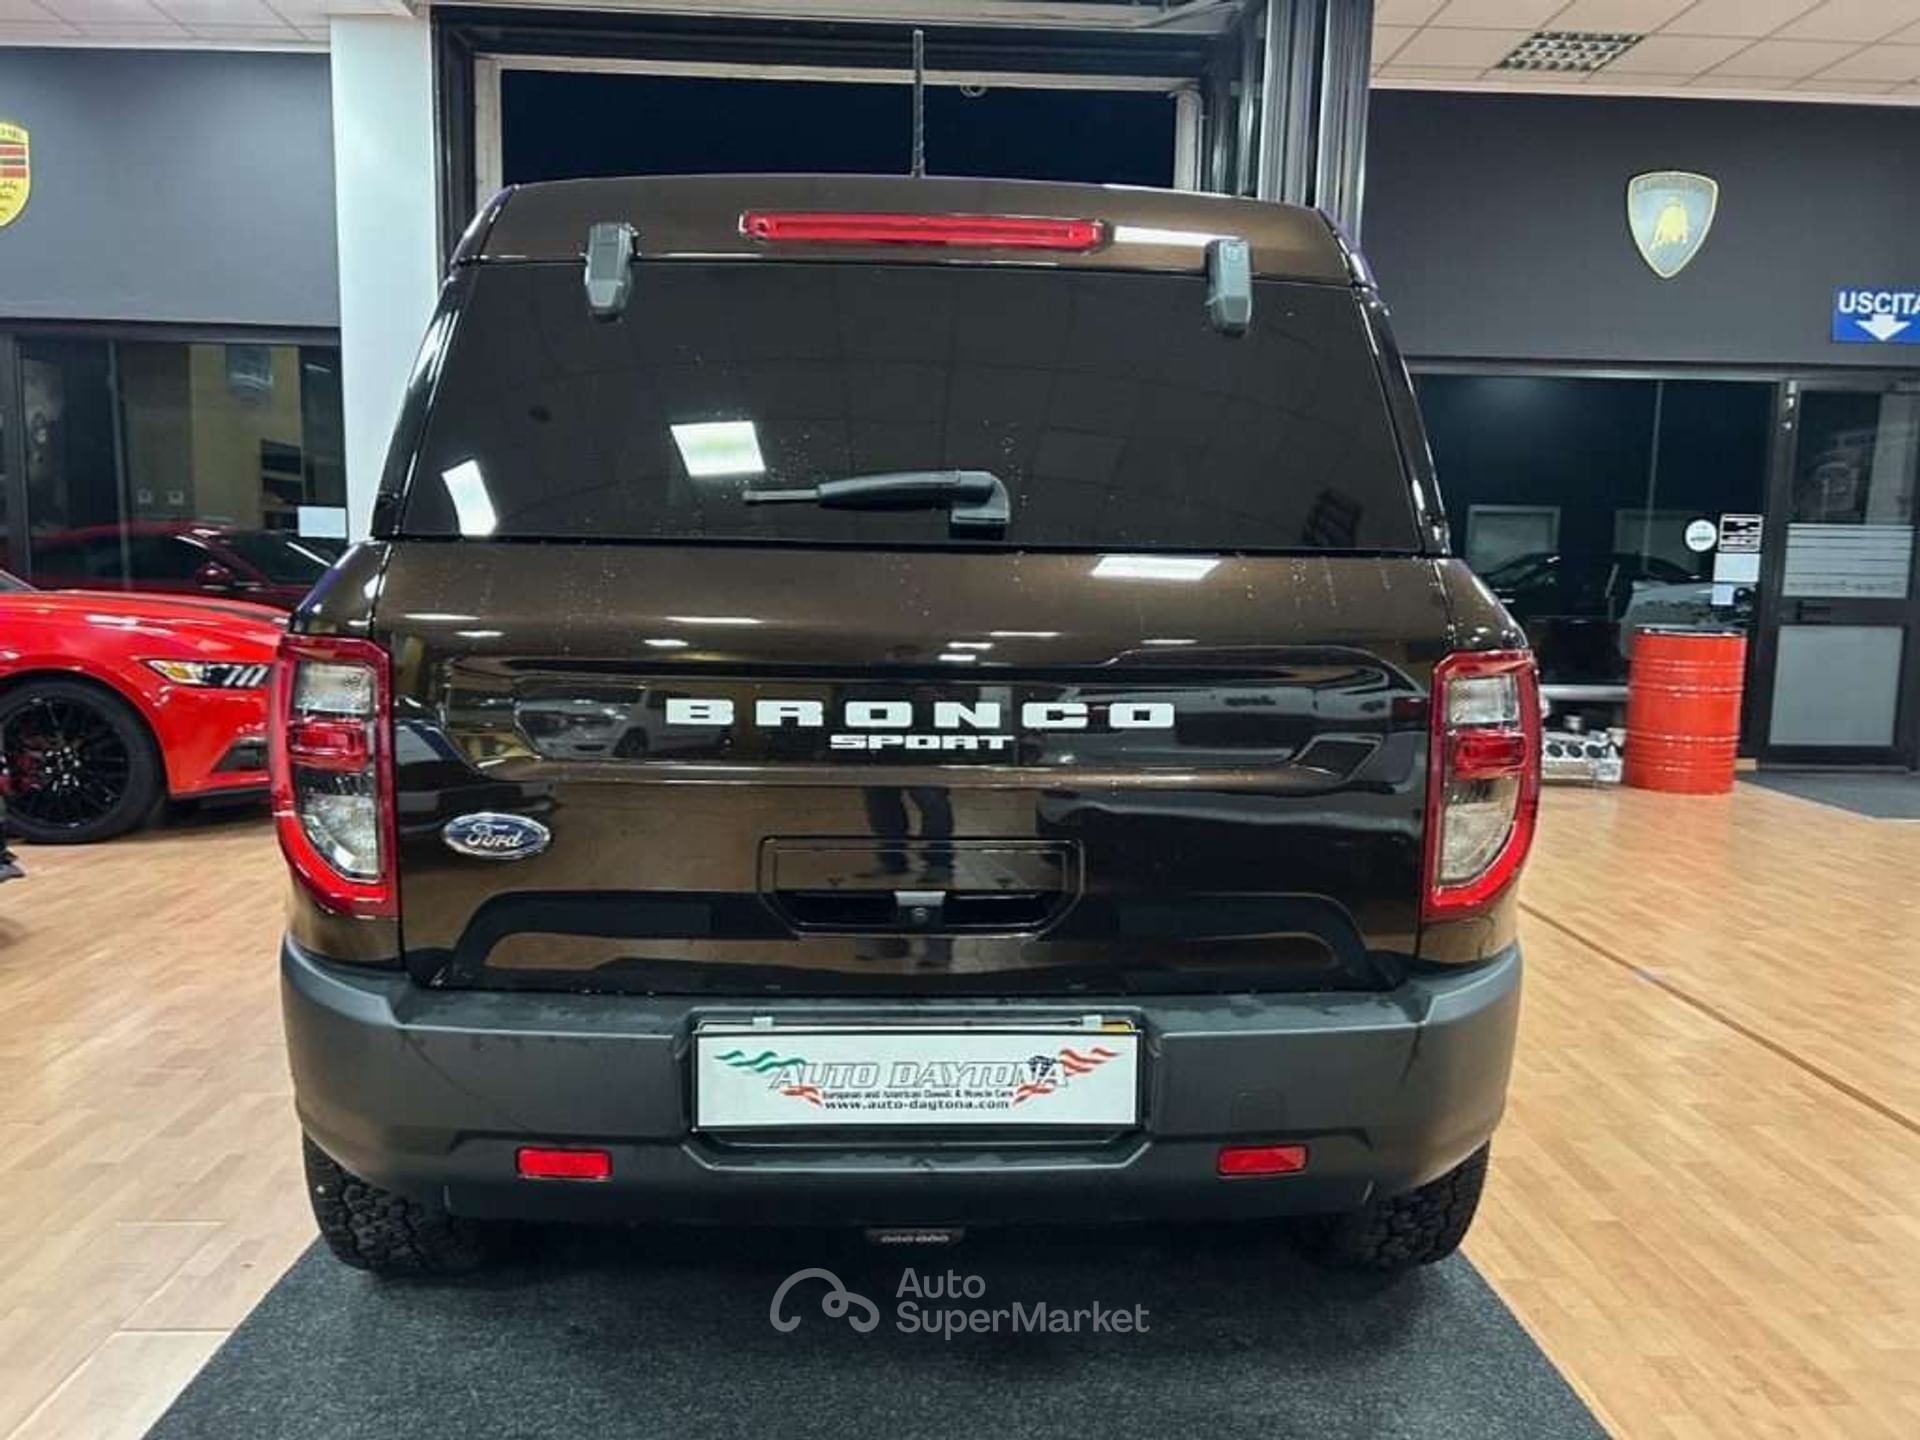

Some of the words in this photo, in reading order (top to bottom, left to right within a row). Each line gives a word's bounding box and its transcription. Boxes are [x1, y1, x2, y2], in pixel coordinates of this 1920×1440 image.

[666, 699, 1175, 728] BRONCO
[830, 734, 1016, 750] SPORT
[465, 822, 524, 847] Ford
[768, 1062, 880, 1089] AUTO
[887, 1061, 1068, 1088] DAYTONA
[825, 1100, 1009, 1111] www.auto-daytona.com
